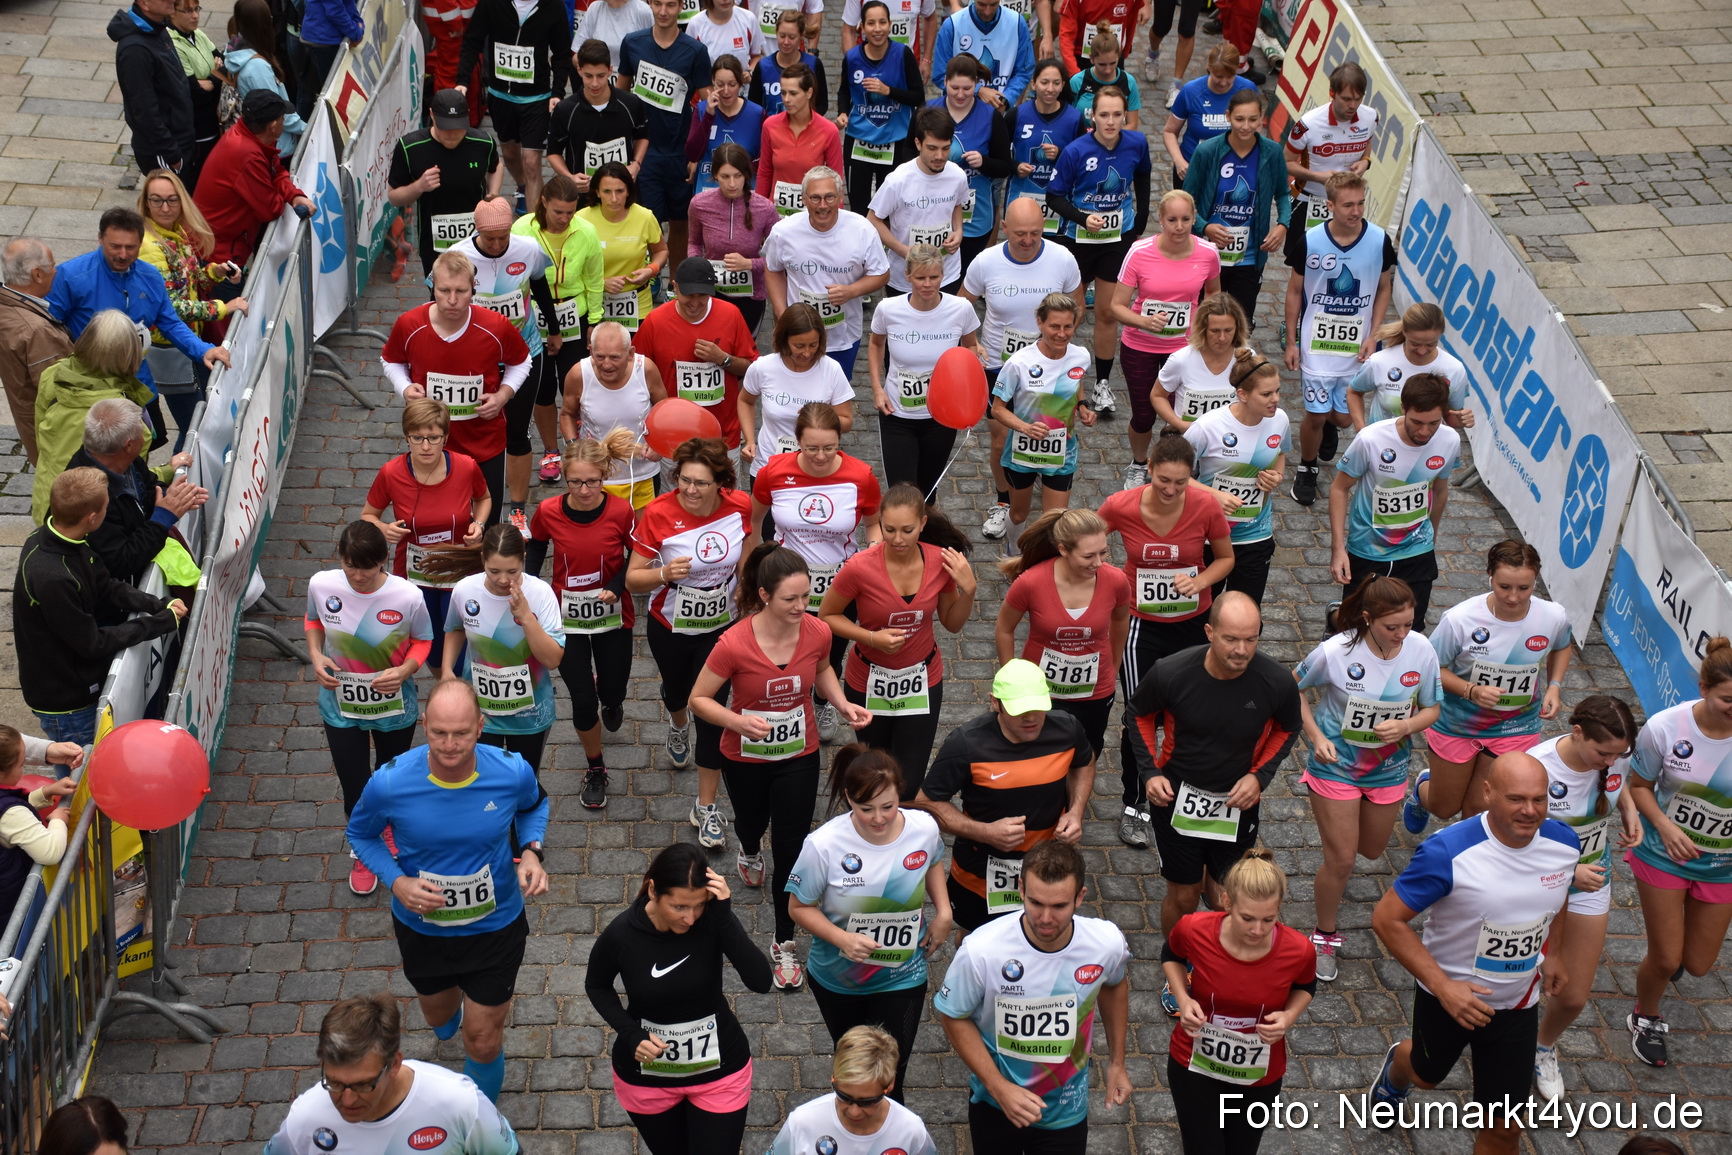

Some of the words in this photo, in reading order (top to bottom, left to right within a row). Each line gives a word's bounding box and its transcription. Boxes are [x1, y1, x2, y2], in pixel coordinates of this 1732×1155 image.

[959, 34, 973, 51] 9
[498, 52, 532, 70] 5119
[853, 69, 865, 84] 9
[640, 71, 675, 96] 5165
[1021, 124, 1034, 139] 5
[588, 148, 624, 167] 5171
[1085, 157, 1098, 172] 8
[1220, 162, 1234, 178] 6
[904, 200, 916, 208] FeG
[930, 195, 957, 205] NEUMARKT
[437, 223, 475, 239] 5052
[1306, 253, 1337, 271] 66
[820, 264, 855, 274] NEUMARKT
[1312, 294, 1371, 308] FIBALON
[537, 311, 576, 328] 545
[921, 332, 953, 341] NEUMARKT
[1317, 323, 1359, 342] 5159
[1319, 342, 1353, 352] Alexander
[428, 377, 445, 385] PARTL
[682, 369, 722, 389] 5170
[432, 386, 479, 404] 5110
[694, 392, 714, 401] Vitaly
[1186, 391, 1203, 399] PARTL
[1018, 435, 1062, 454] 5090
[1377, 492, 1425, 514] 5319
[681, 596, 727, 618] 5039
[1157, 604, 1178, 613] Julia
[686, 619, 721, 628] Christine
[1469, 645, 1490, 653] PARTL
[1608, 582, 1634, 623] AUF
[1631, 614, 1661, 669] JEDER
[1658, 661, 1682, 707] STRE
[1044, 652, 1063, 664] PARTL
[473, 666, 489, 677] PARTL
[490, 671, 519, 680] Neumarkt
[870, 668, 891, 679] PARTL
[891, 668, 918, 680] Neumarkt
[1045, 661, 1092, 684] 5181
[1474, 663, 1497, 673] PARTL
[335, 675, 356, 683] PARTL
[1476, 672, 1531, 693] 5114
[478, 676, 527, 699] 5079
[873, 675, 923, 699] 5096
[353, 703, 389, 715] Krystyna
[487, 700, 520, 710] Jennifer
[889, 700, 906, 710] Lisa
[1349, 700, 1372, 711] PARTL
[1372, 704, 1403, 712] Neumarkt
[766, 714, 795, 723] Neumarkt
[763, 747, 785, 755] Julia
[1670, 759, 1692, 769] PARTL
[1182, 792, 1232, 819] 5321
[1673, 795, 1699, 808] PARTL
[1674, 804, 1732, 837] 5078
[989, 859, 1013, 872] PARTL
[446, 877, 482, 887] Neumarkt
[441, 882, 489, 908] 316
[850, 917, 875, 925] PARTL
[1482, 926, 1511, 937] PARTL
[1511, 923, 1542, 937] Neumarkt
[1484, 929, 1544, 958] 2535
[867, 952, 902, 962] xandra
[1504, 962, 1525, 972] Karl
[1000, 984, 1025, 992] PARTL
[997, 1001, 1024, 1012] PARTL
[1025, 1001, 1063, 1012] Neumarkt
[1004, 1011, 1070, 1037] 5025
[643, 1025, 668, 1037] PARTL
[668, 1025, 705, 1037] Neumarkt
[1222, 1033, 1258, 1045] Neumarkt
[1010, 1041, 1063, 1054] Alexander
[1201, 1038, 1264, 1066] 5087
[1209, 1061, 1247, 1078] Sabrina
